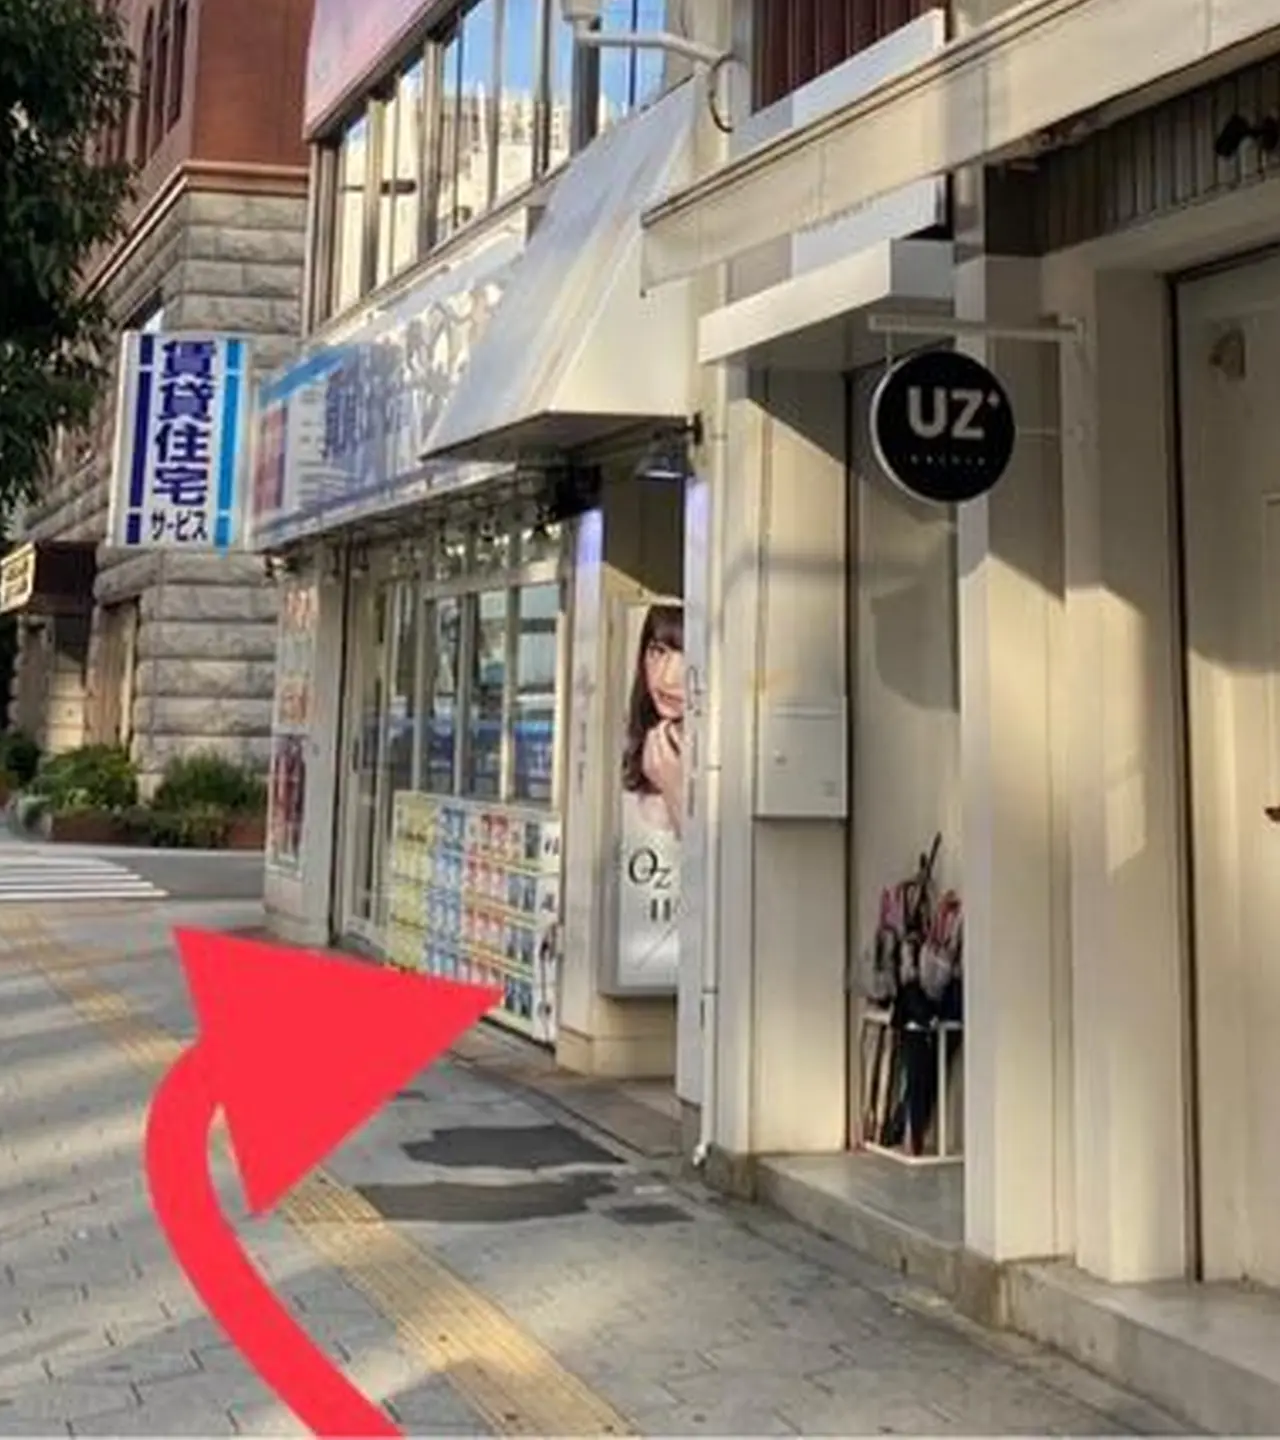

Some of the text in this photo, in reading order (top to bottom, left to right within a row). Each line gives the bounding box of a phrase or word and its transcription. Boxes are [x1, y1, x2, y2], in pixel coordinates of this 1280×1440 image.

[151, 339, 217, 506] 賃貸住宅
[907, 385, 986, 438] UZ
[150, 509, 209, 541] サービス
